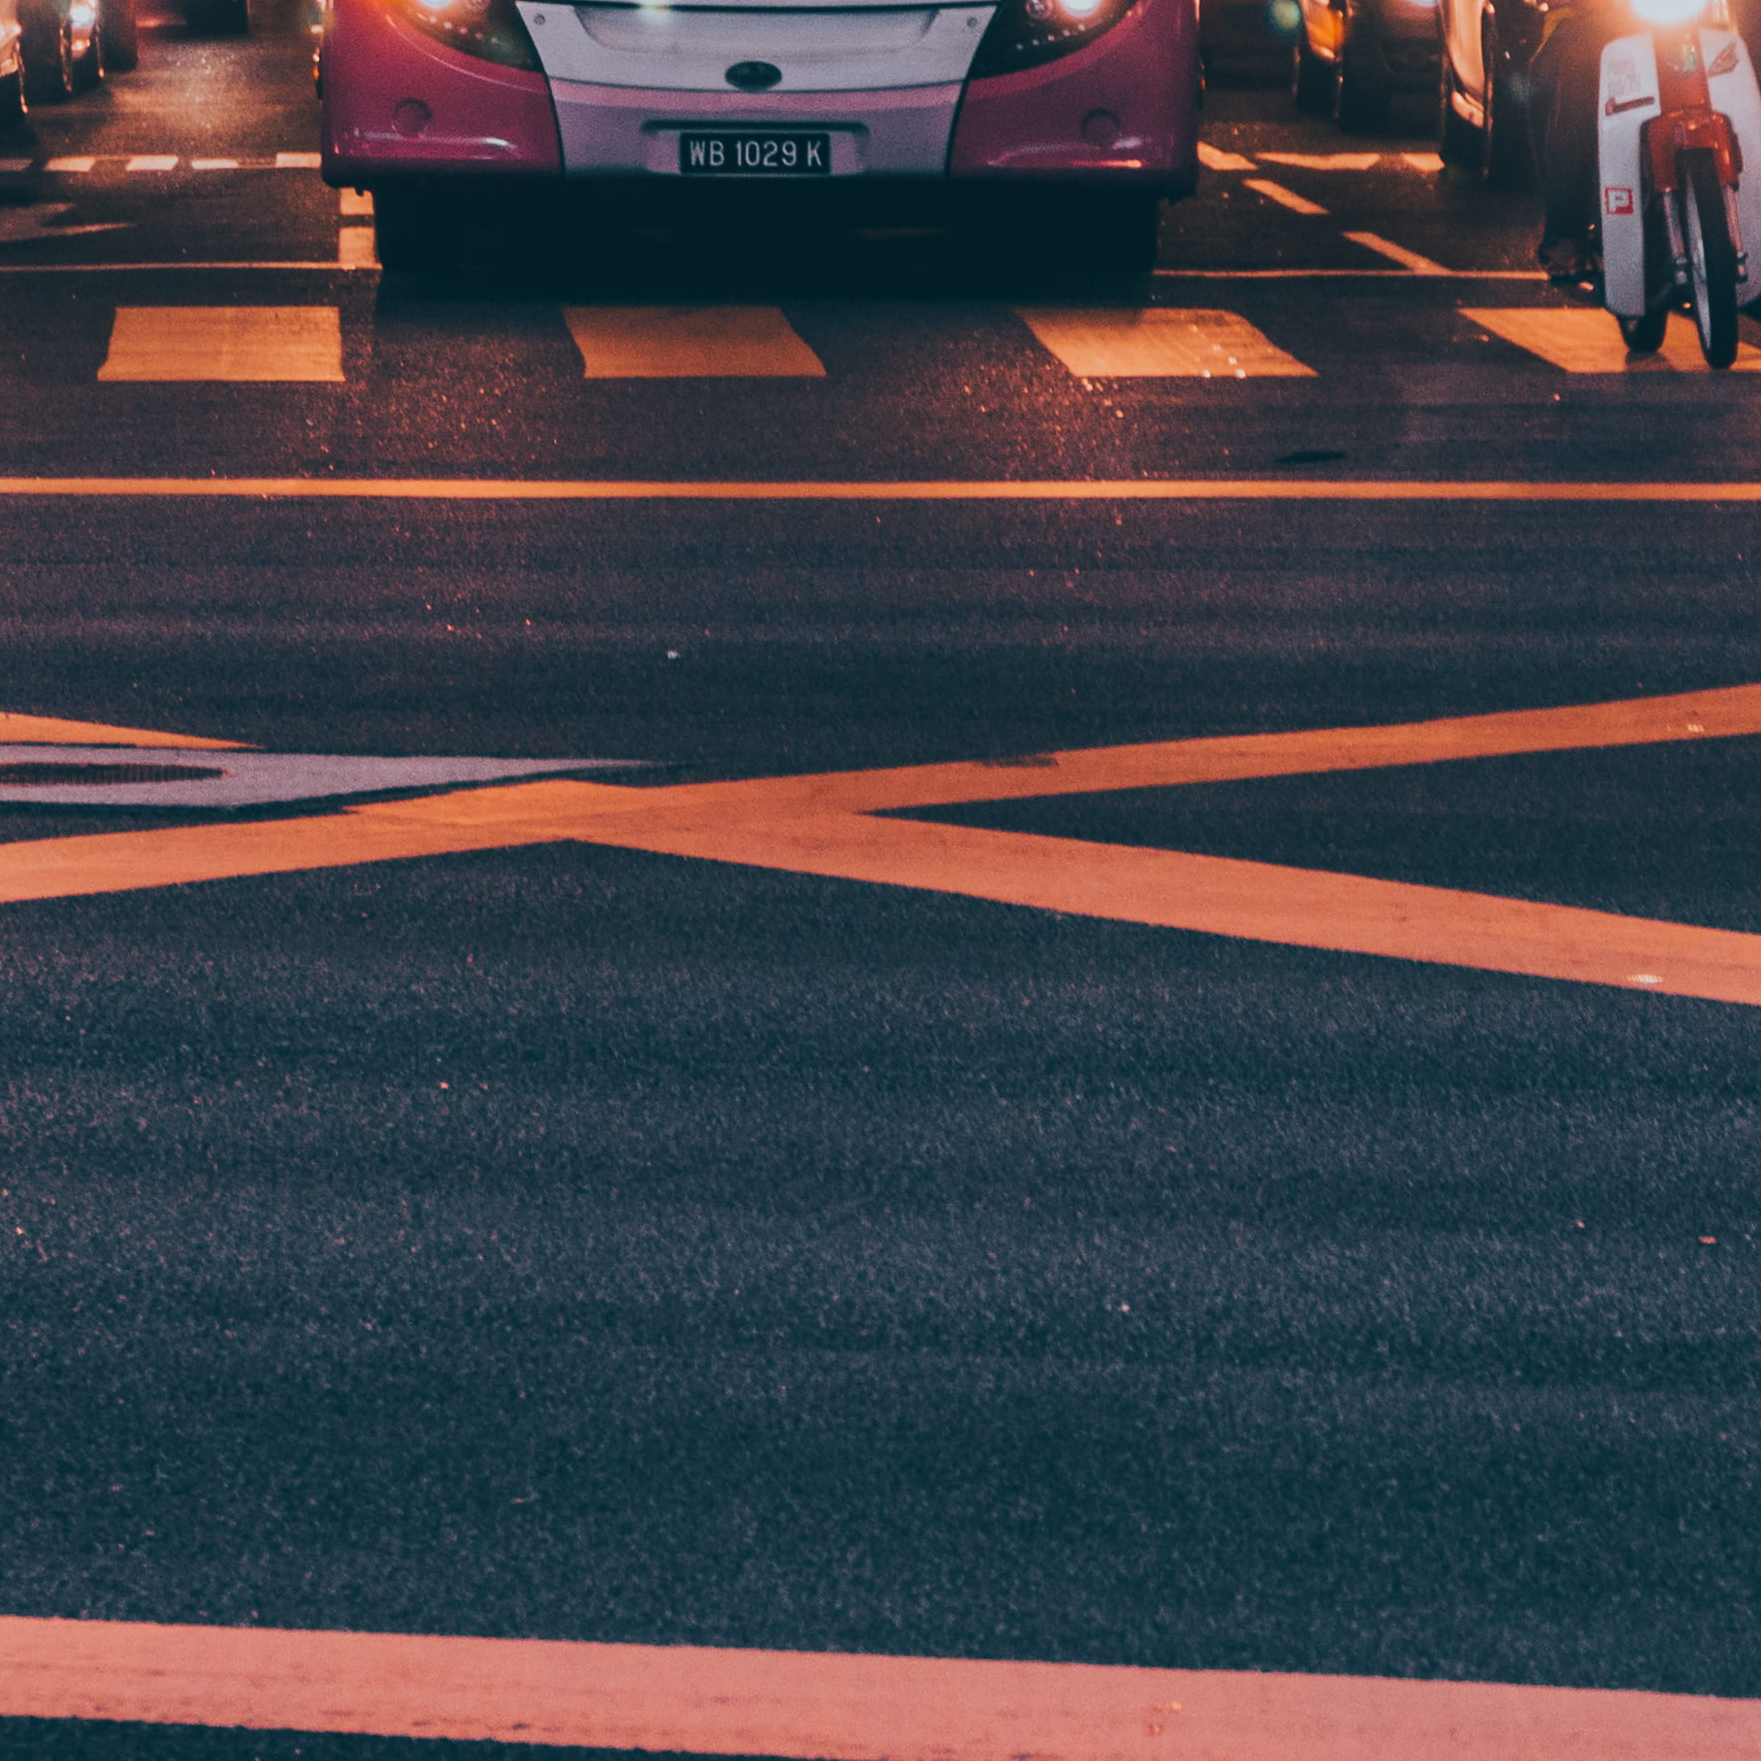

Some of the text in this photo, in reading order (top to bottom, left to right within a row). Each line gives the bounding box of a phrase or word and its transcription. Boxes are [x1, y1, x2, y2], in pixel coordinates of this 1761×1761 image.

[689, 140, 822, 167] WB 1029 K
